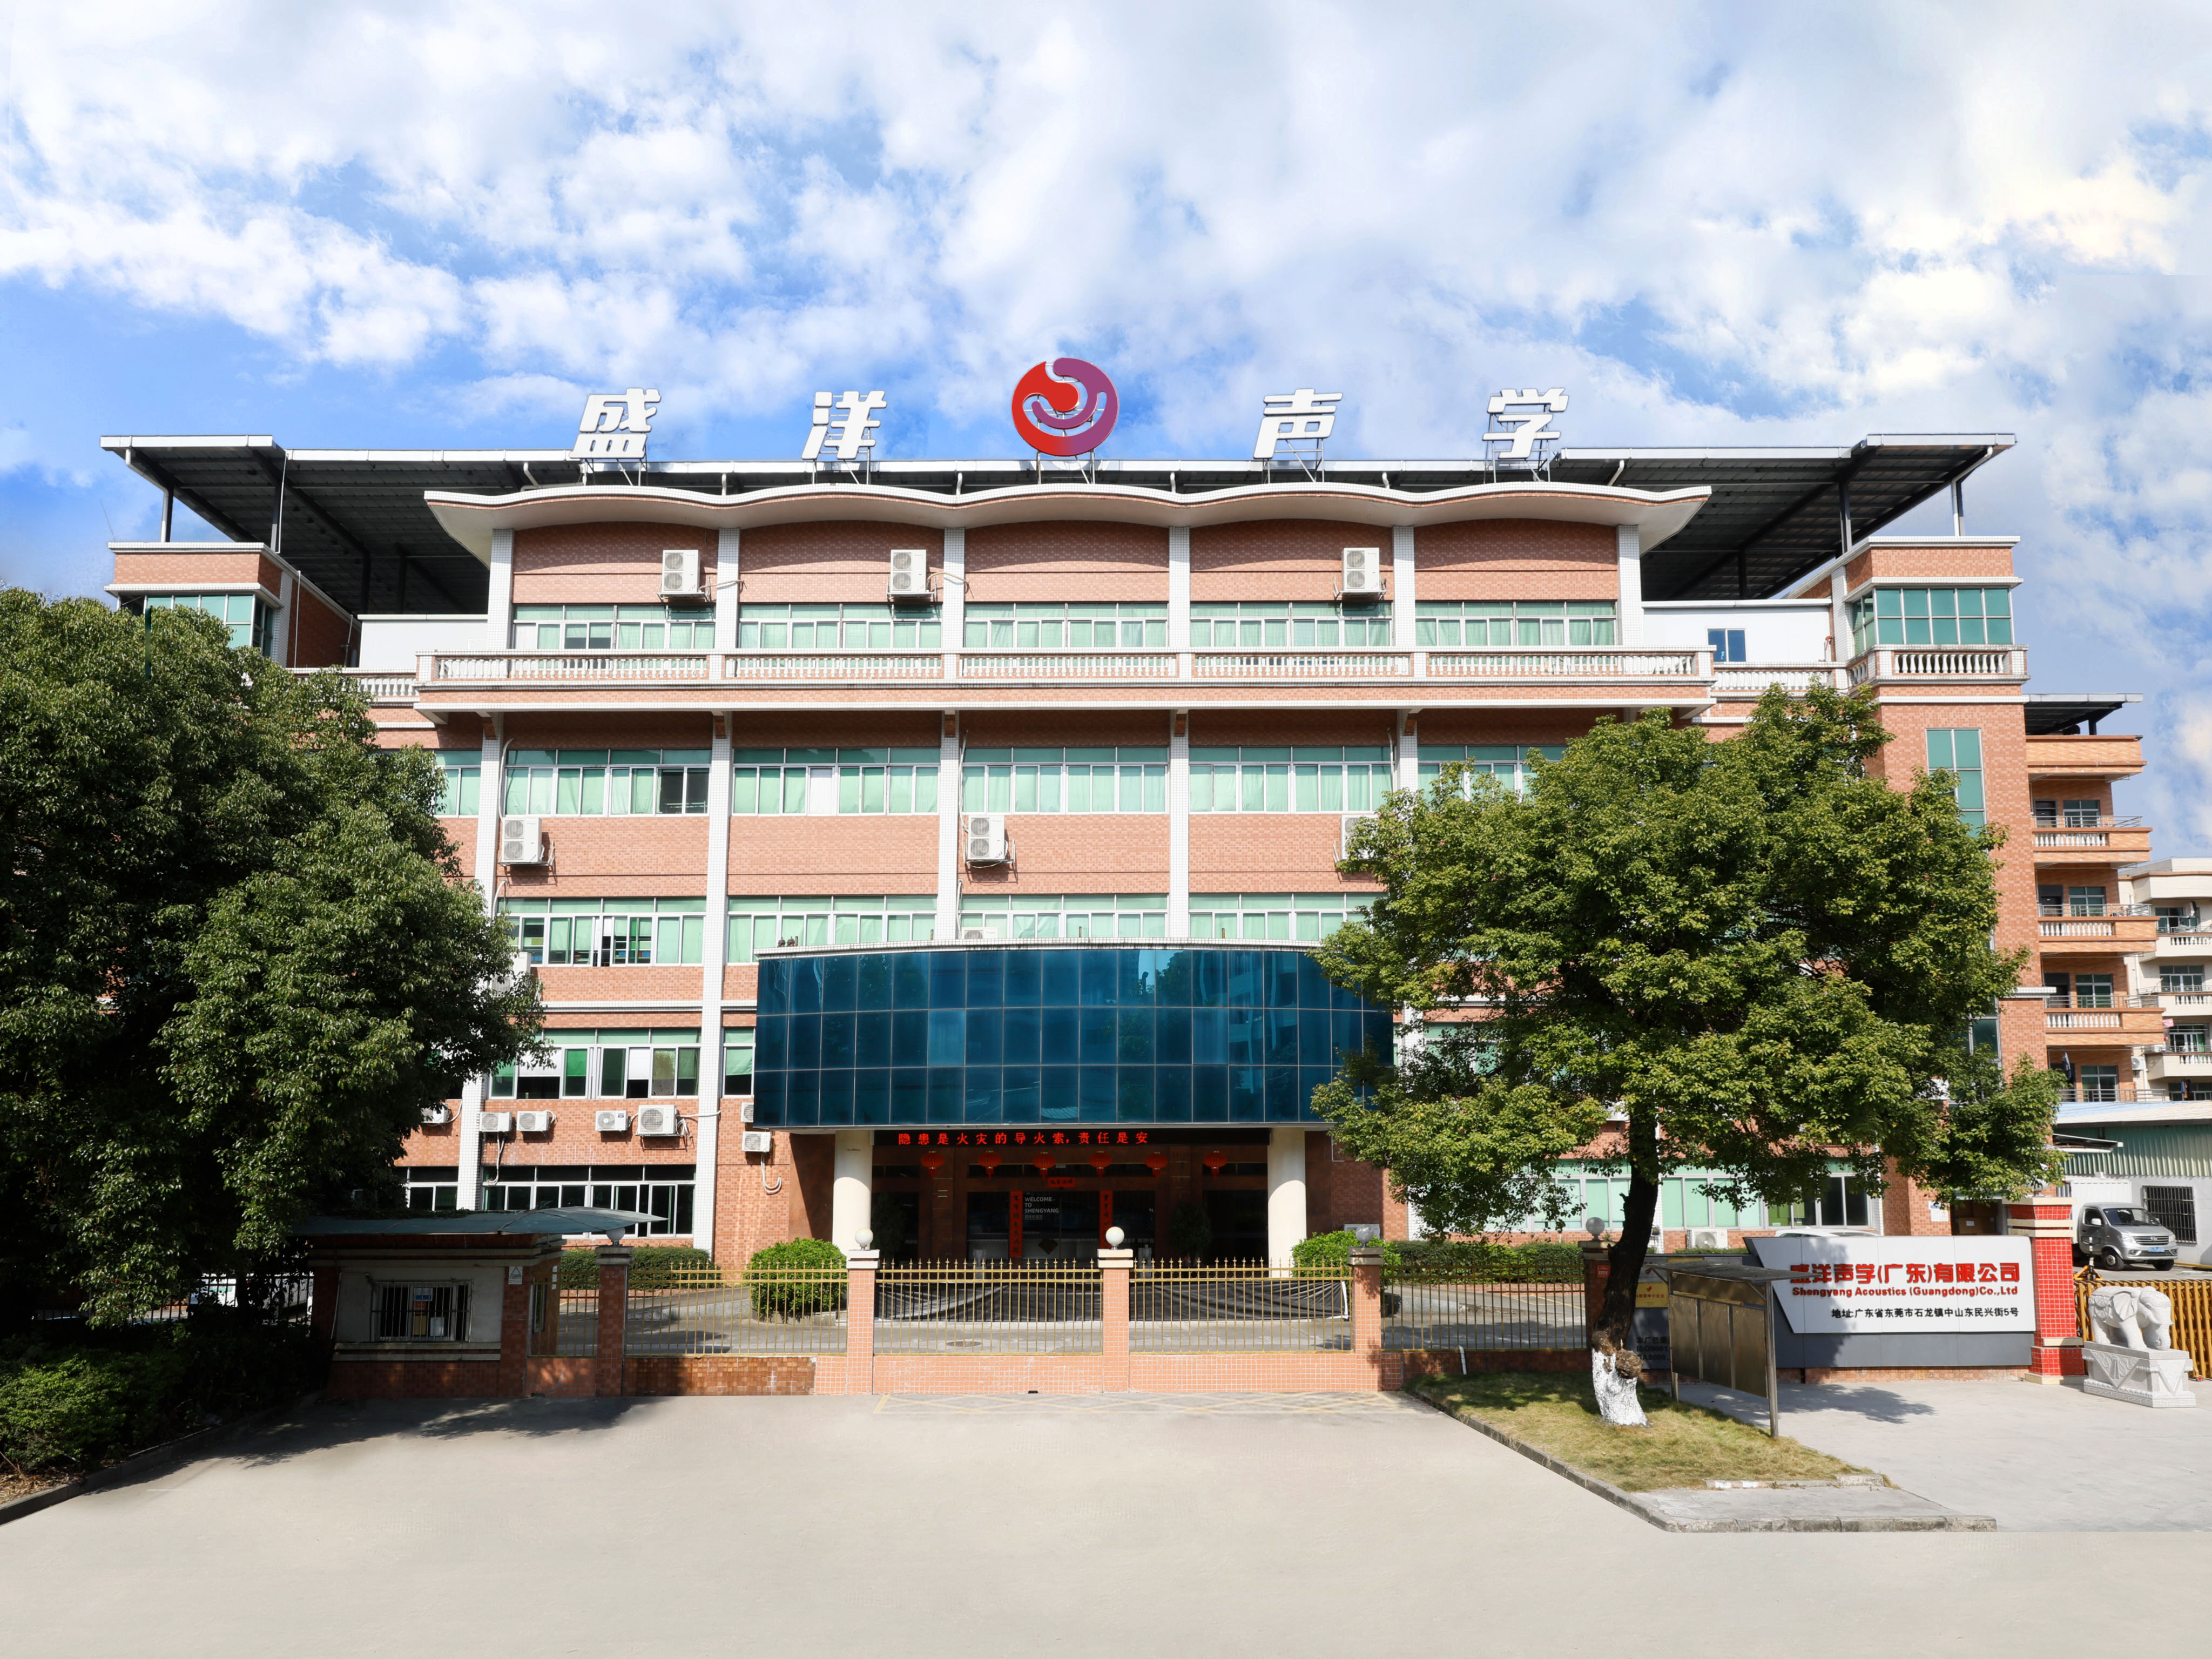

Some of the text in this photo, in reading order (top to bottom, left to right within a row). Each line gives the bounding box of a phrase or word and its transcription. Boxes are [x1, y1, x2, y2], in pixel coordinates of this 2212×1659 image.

[569, 387, 1569, 460] 盛 洋 声 学
[1792, 1287, 1852, 1297] Shengyang
[1855, 1287, 1906, 1296] Acoustics
